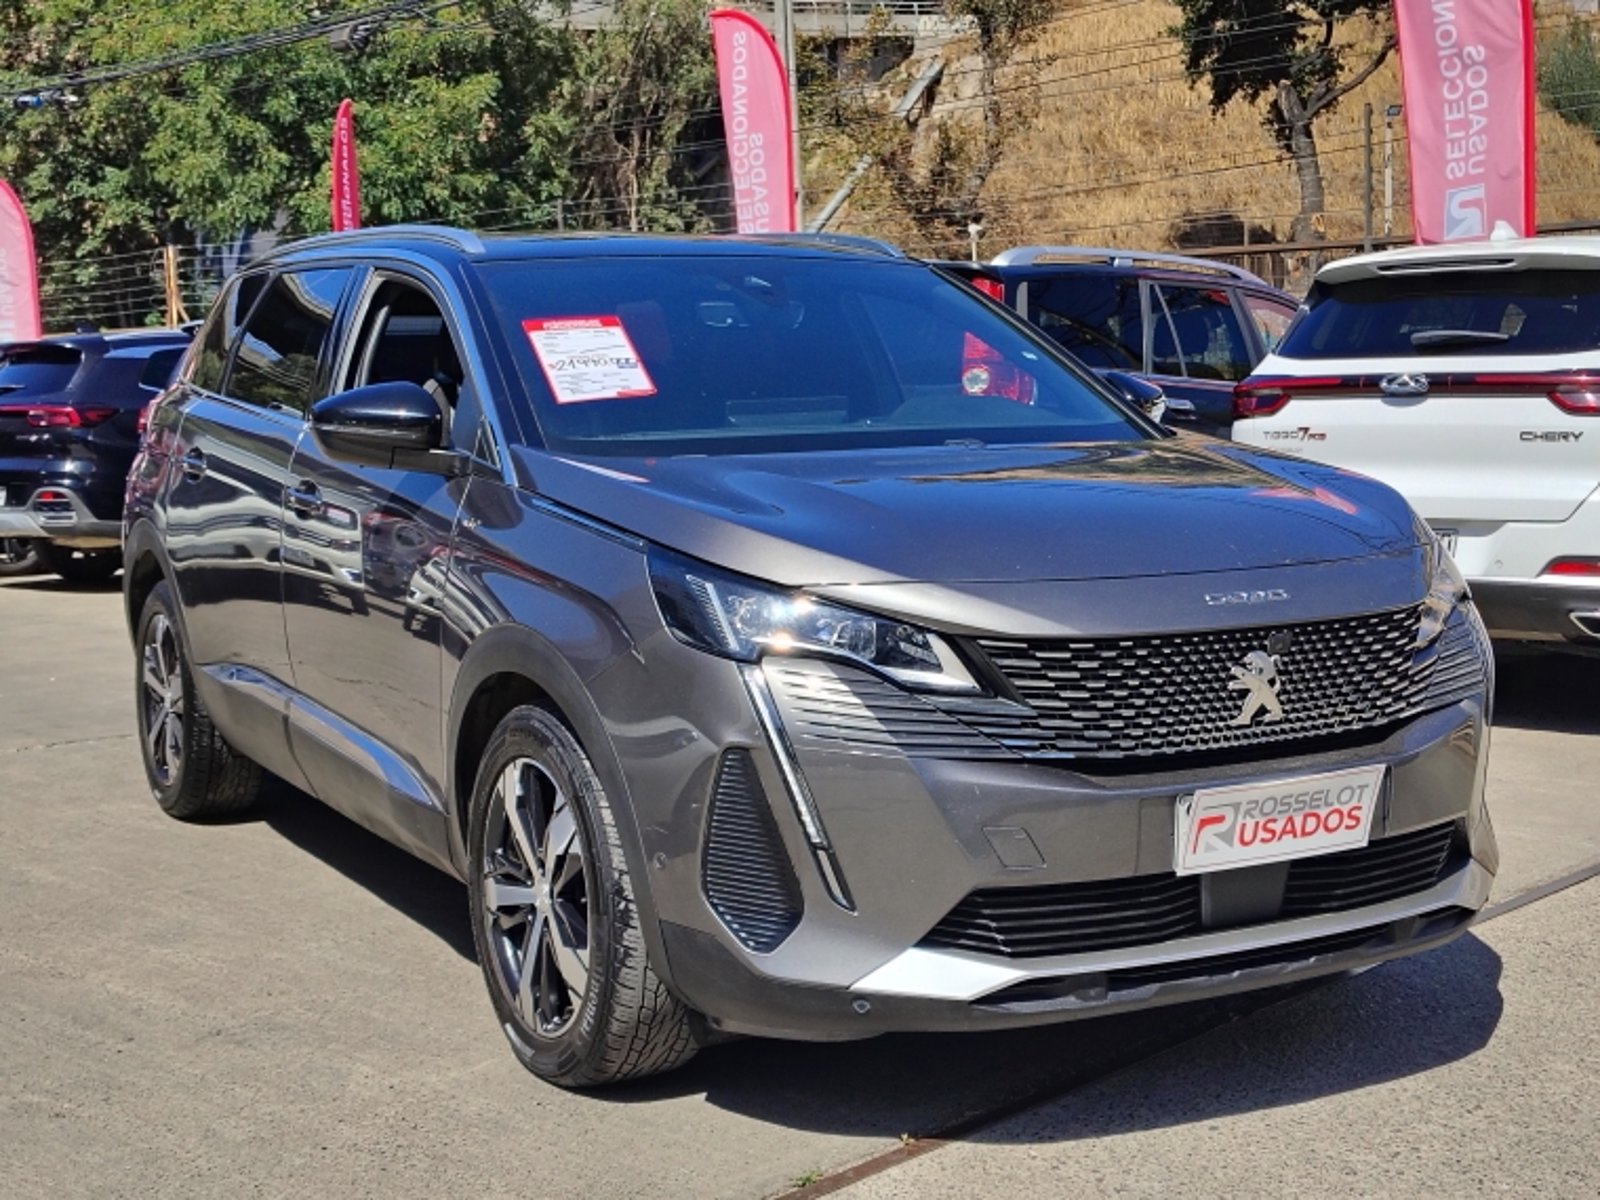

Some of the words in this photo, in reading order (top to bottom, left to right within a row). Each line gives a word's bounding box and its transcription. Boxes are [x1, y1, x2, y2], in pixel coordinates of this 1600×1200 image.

[1519, 431, 1584, 442] CHERY
[1242, 784, 1369, 819] ROSSELOT
[1239, 806, 1362, 847] USADOS
